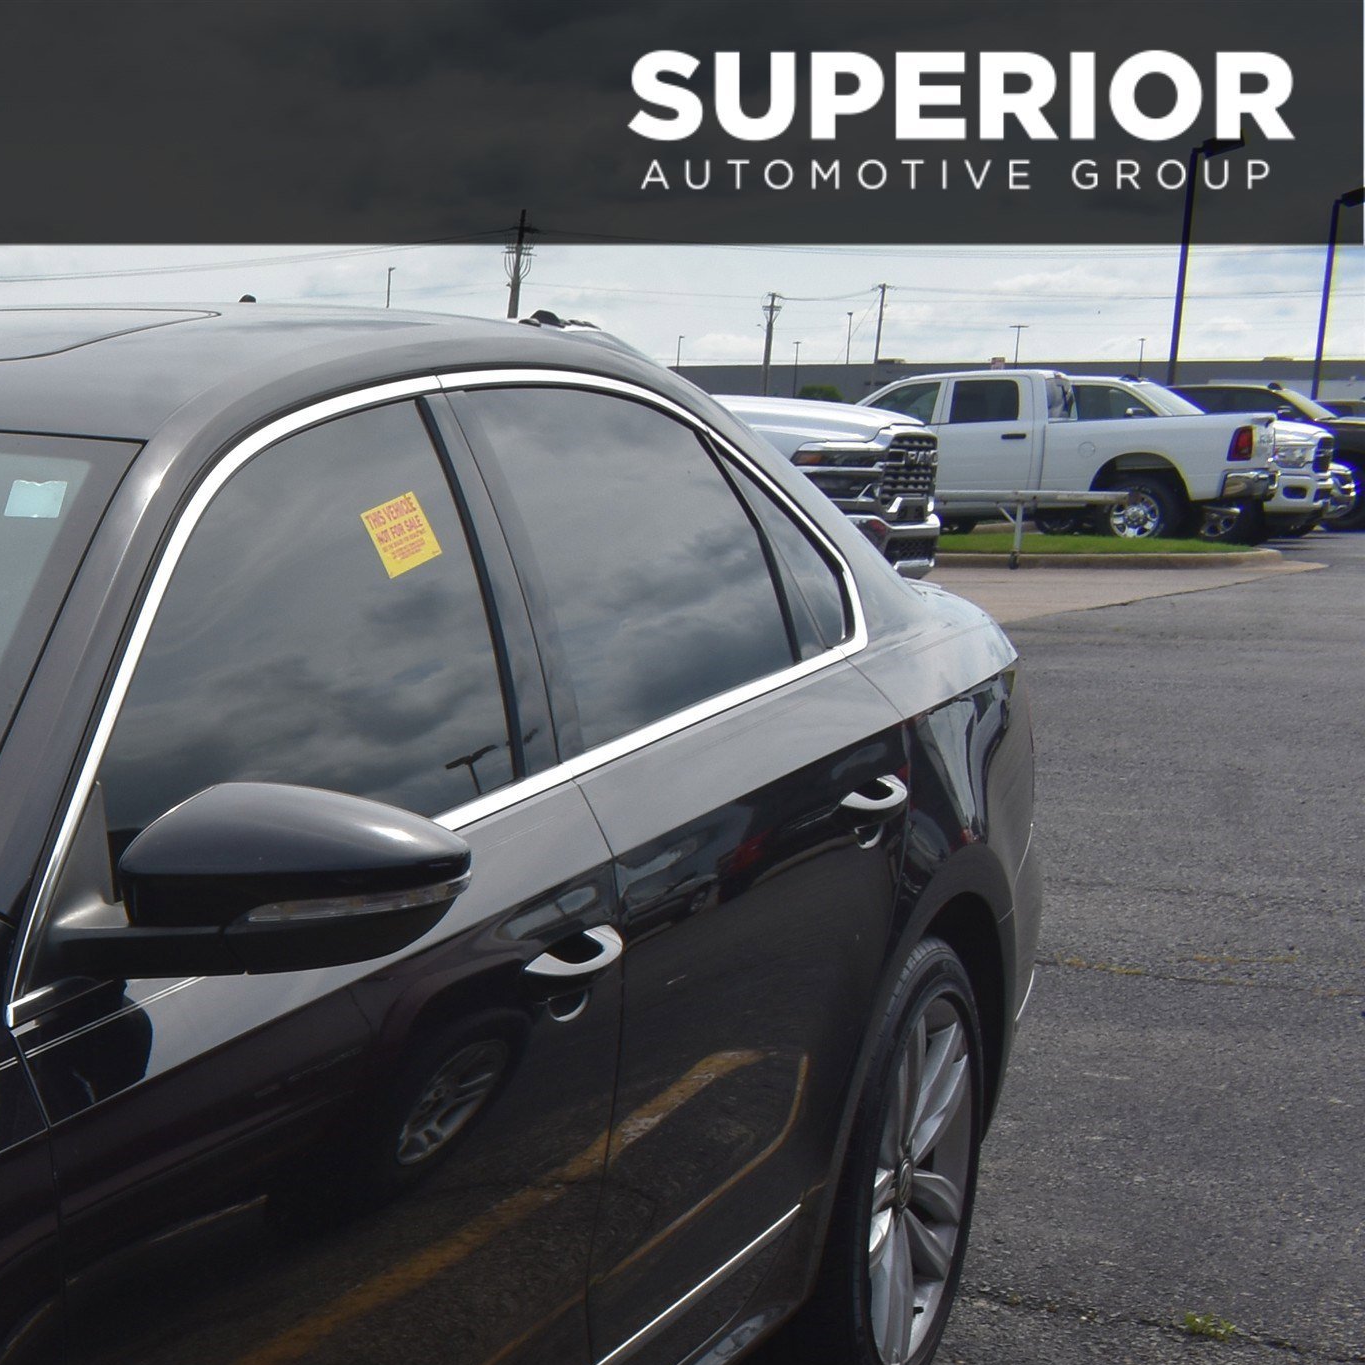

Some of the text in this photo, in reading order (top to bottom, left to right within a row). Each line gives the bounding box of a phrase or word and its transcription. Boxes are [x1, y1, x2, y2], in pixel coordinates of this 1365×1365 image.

[365, 497, 417, 530] THIS VEHICLE
[376, 529, 392, 545] NOT
[389, 523, 406, 539] FOR
[404, 515, 424, 531] SALE
